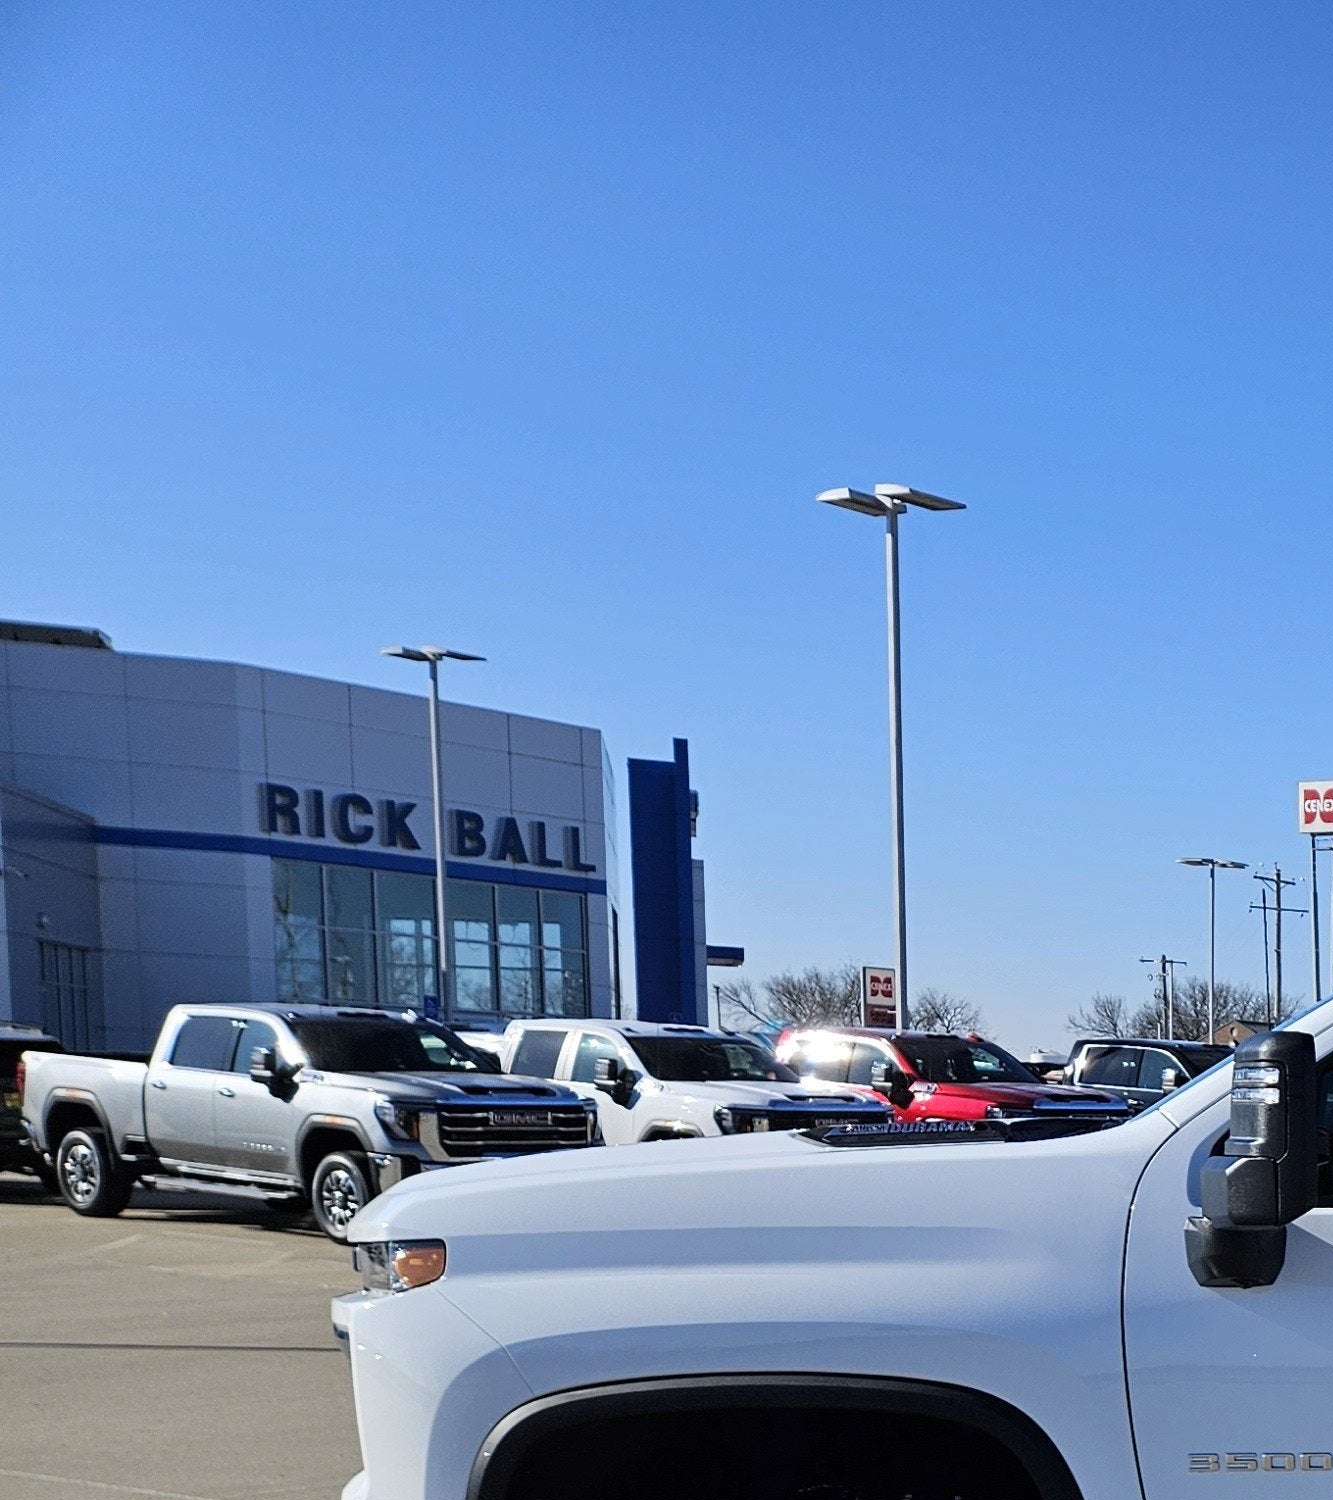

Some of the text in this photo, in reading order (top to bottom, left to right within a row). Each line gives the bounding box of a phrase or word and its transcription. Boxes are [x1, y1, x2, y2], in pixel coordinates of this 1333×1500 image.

[257, 782, 597, 873] RICK BALL
[1187, 1452, 1333, 1472] 3500
